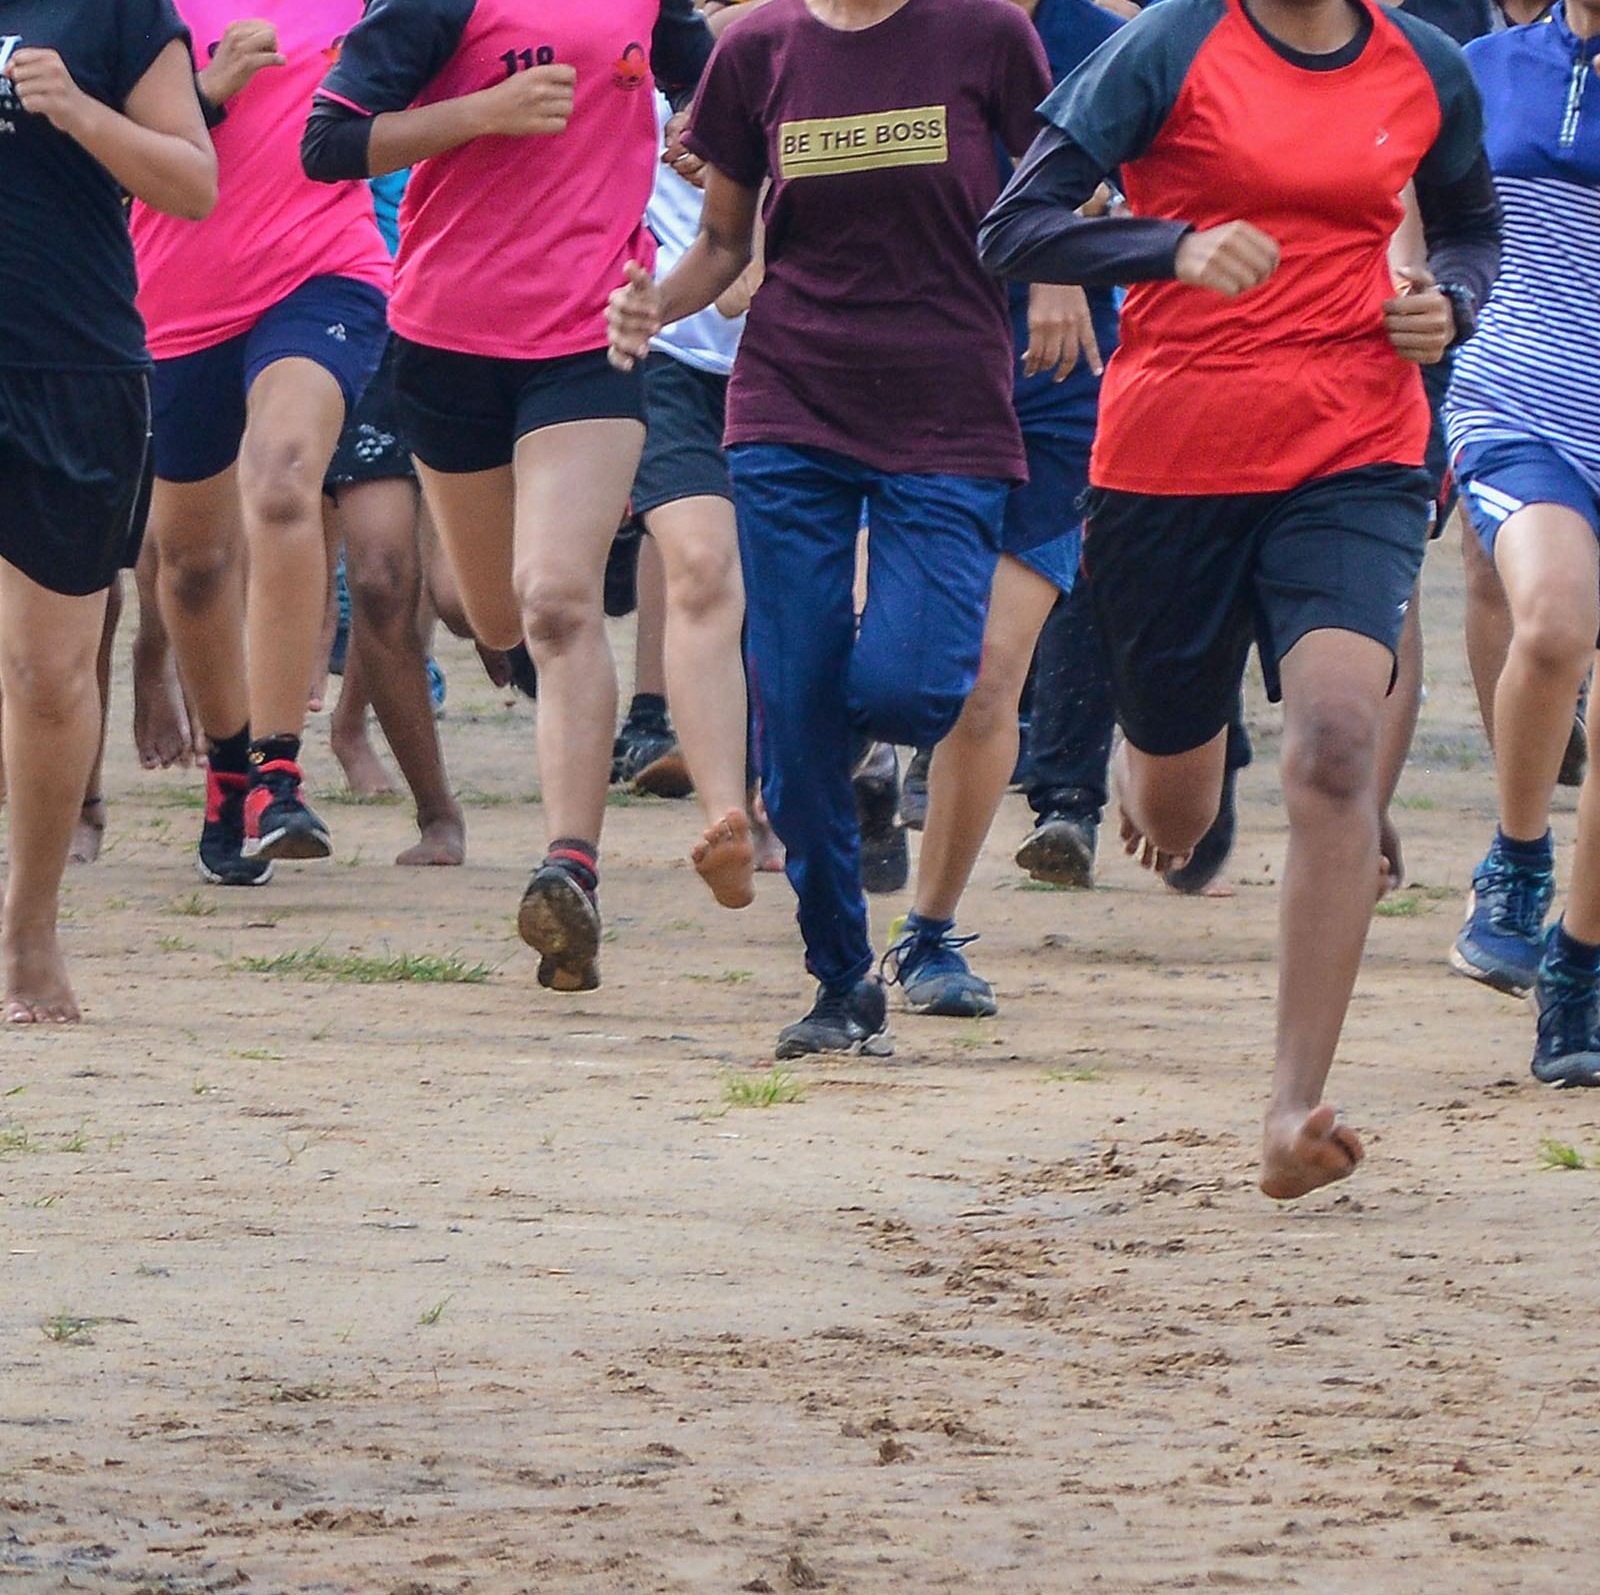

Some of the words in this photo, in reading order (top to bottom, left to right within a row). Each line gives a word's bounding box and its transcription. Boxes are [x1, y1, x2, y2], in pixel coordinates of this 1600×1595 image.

[784, 133, 811, 155] BE
[820, 128, 868, 151] THE
[876, 119, 942, 145] BOSS
